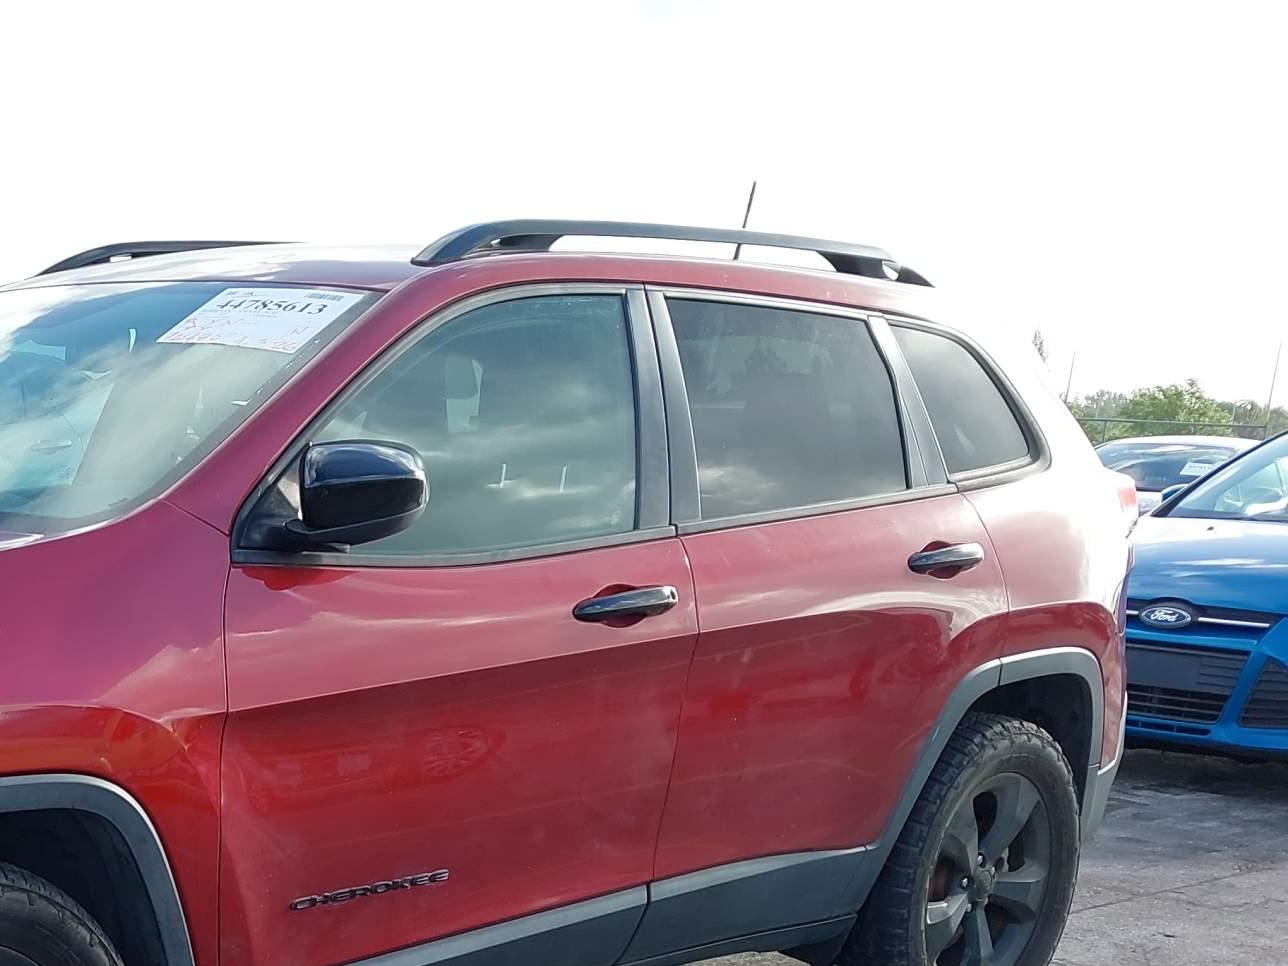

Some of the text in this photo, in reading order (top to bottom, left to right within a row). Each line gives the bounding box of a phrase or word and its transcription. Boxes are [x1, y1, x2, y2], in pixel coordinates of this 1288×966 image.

[217, 298, 328, 315] 44785613
[1150, 609, 1179, 622] Ford
[289, 868, 449, 911] CHEROKEE
